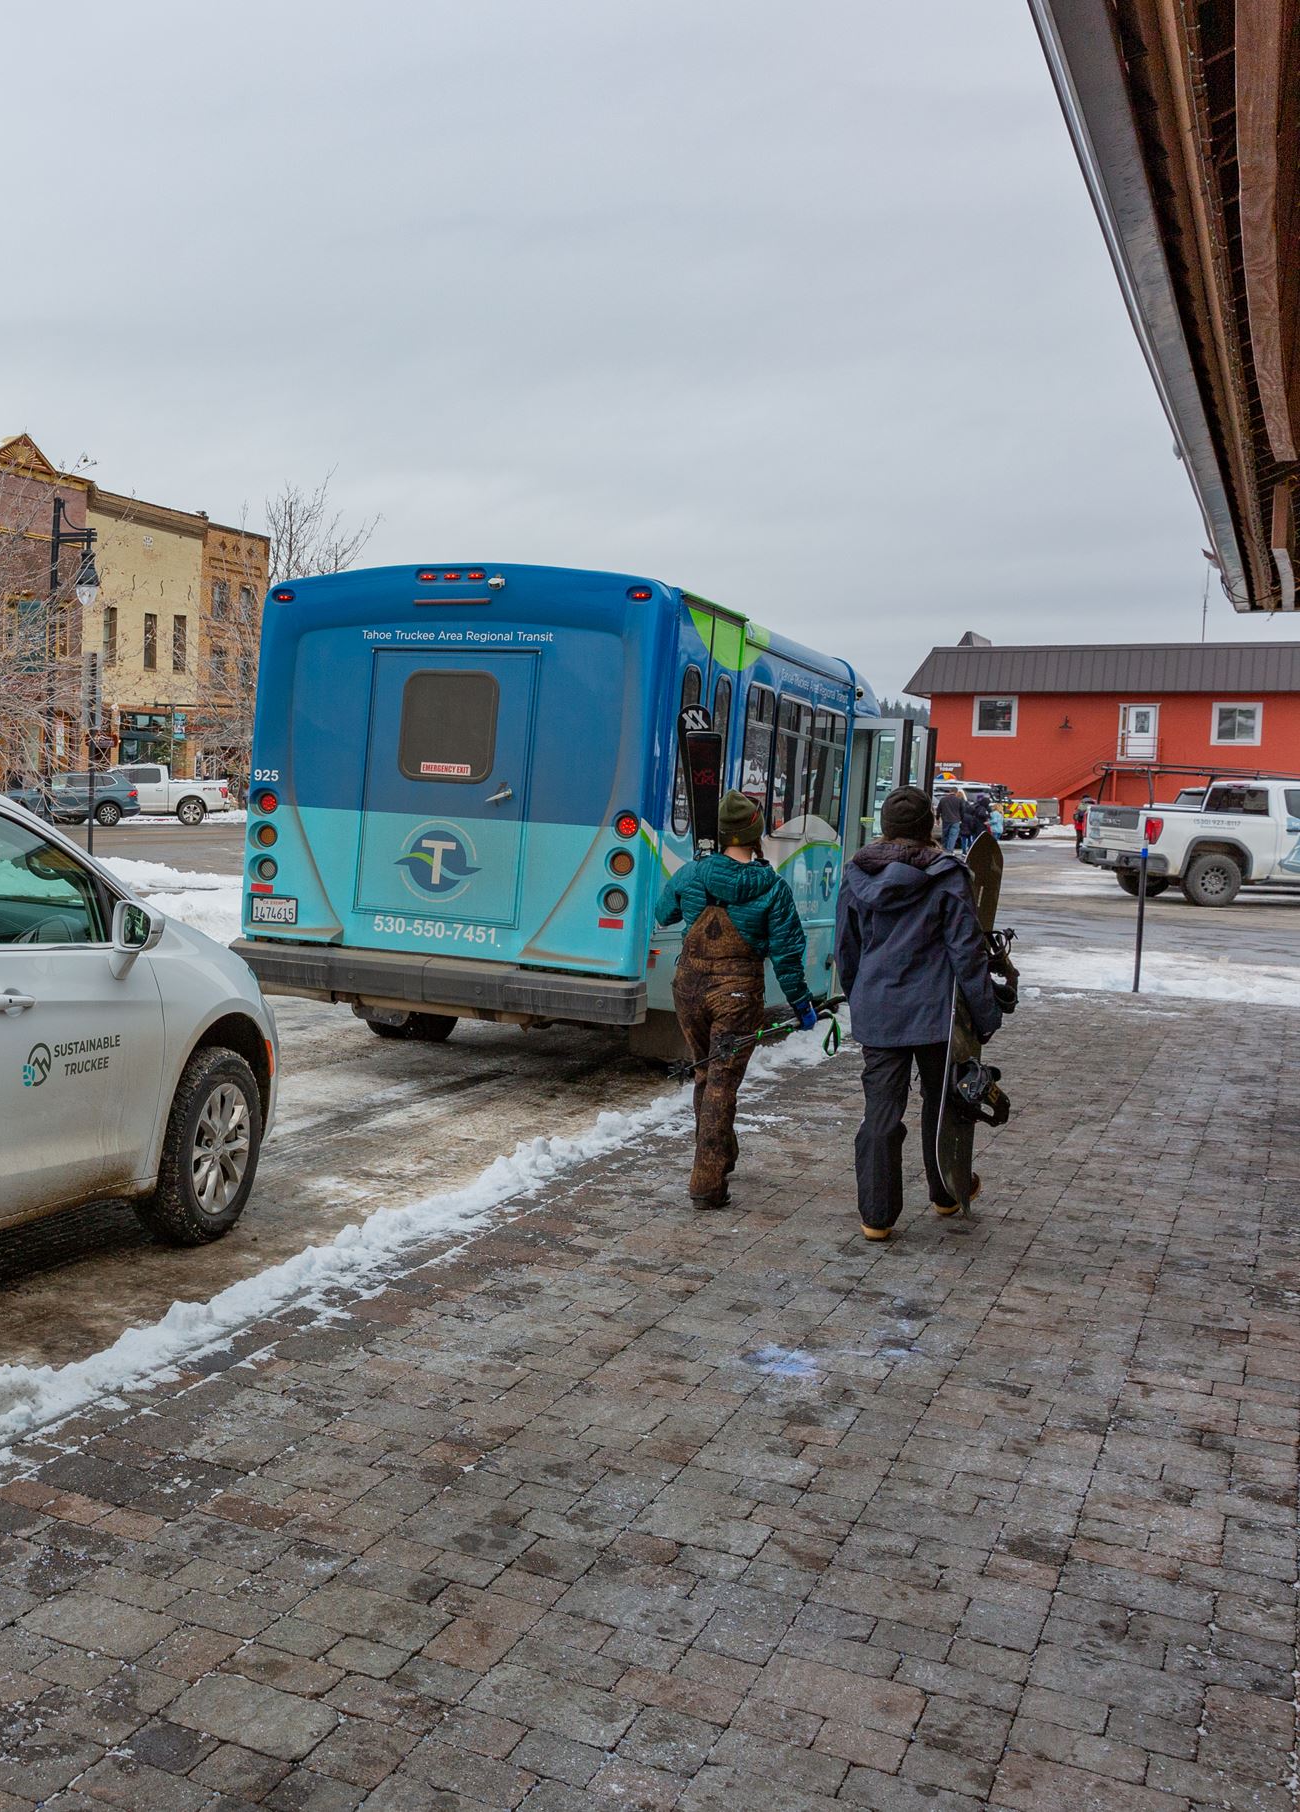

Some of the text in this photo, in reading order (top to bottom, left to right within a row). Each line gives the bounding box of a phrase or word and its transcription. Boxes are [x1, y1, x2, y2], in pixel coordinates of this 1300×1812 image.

[362, 630, 554, 642] Tahoe Truckee Area Regional Transit
[254, 769, 279, 782] 925
[422, 763, 470, 774] EMERGENCY EXIT
[421, 839, 457, 885] T
[254, 906, 294, 921] 1474615
[373, 914, 497, 944] 530-550-7451
[54, 1034, 120, 1058] SUSTAINABLE
[64, 1056, 110, 1076] TRUCKEE
